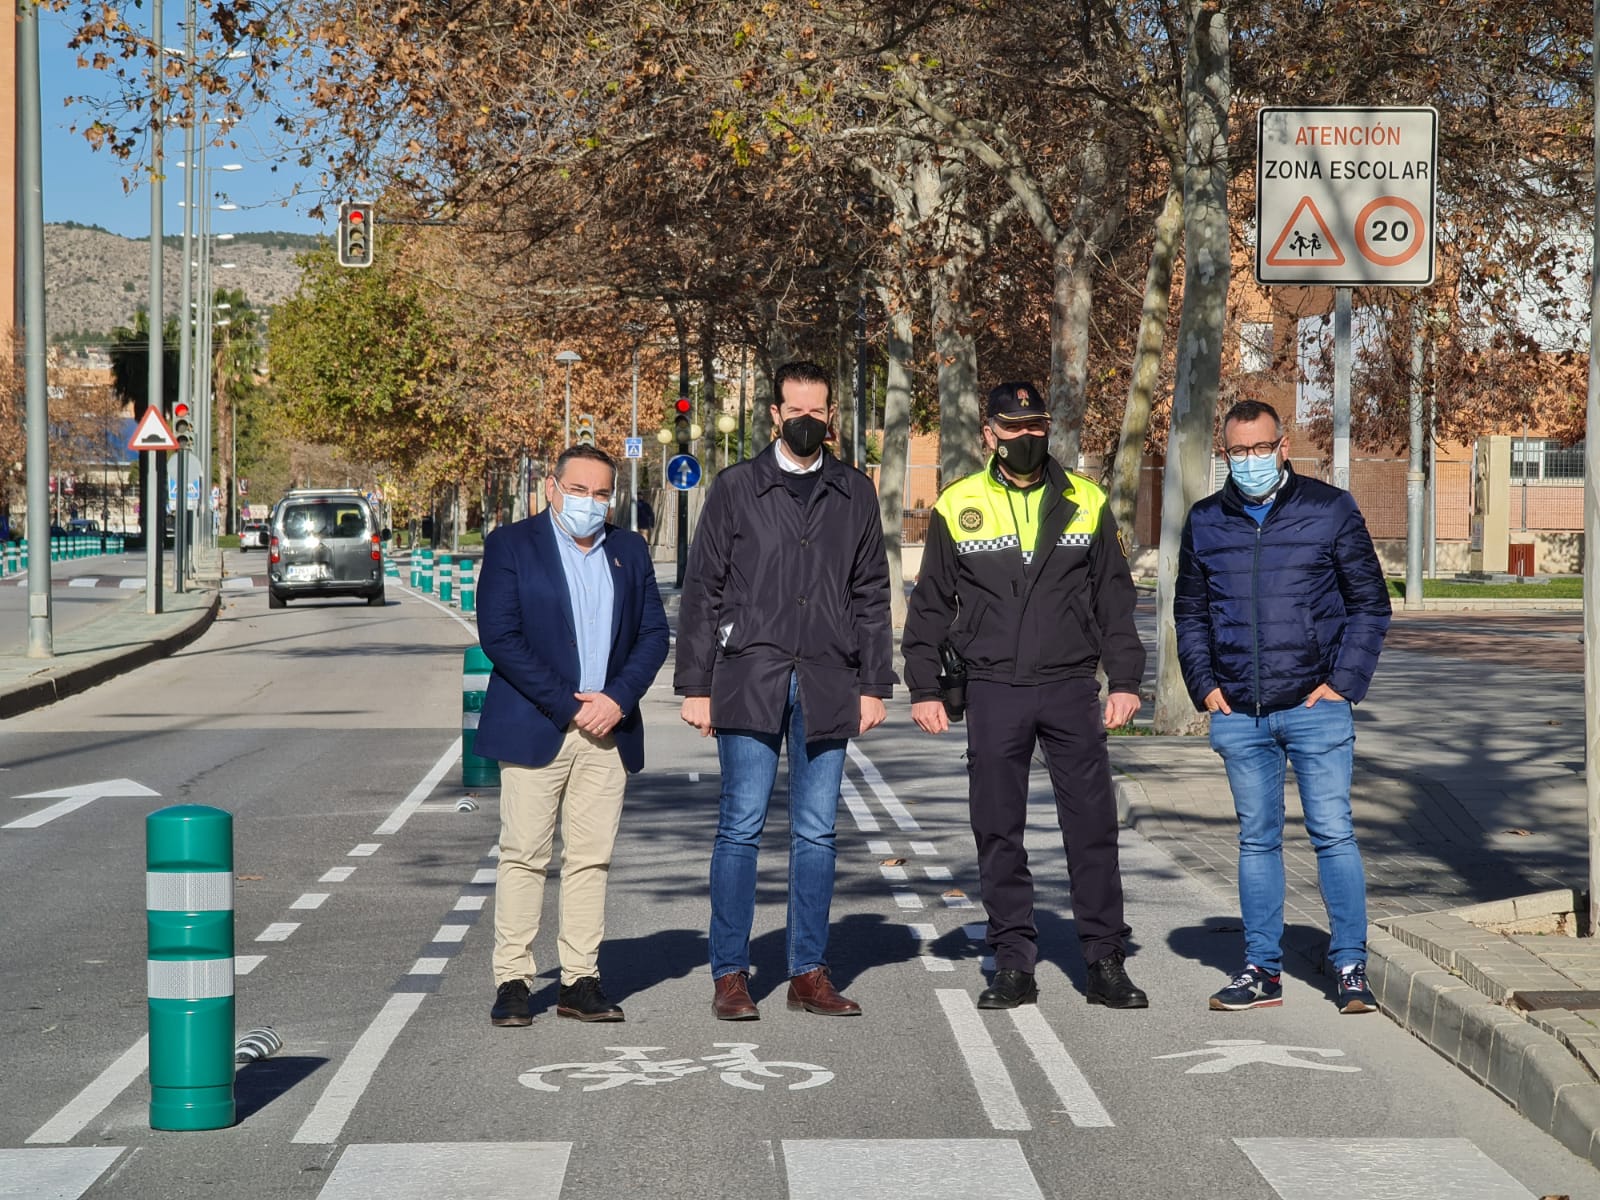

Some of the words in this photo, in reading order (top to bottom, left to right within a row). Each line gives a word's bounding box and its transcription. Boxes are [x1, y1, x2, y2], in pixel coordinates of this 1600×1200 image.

[1295, 121, 1401, 146] ATENCIÓN
[1264, 160, 1322, 180] ZONA
[1330, 160, 1429, 180] ESCOLAR
[1371, 220, 1409, 242] 20
